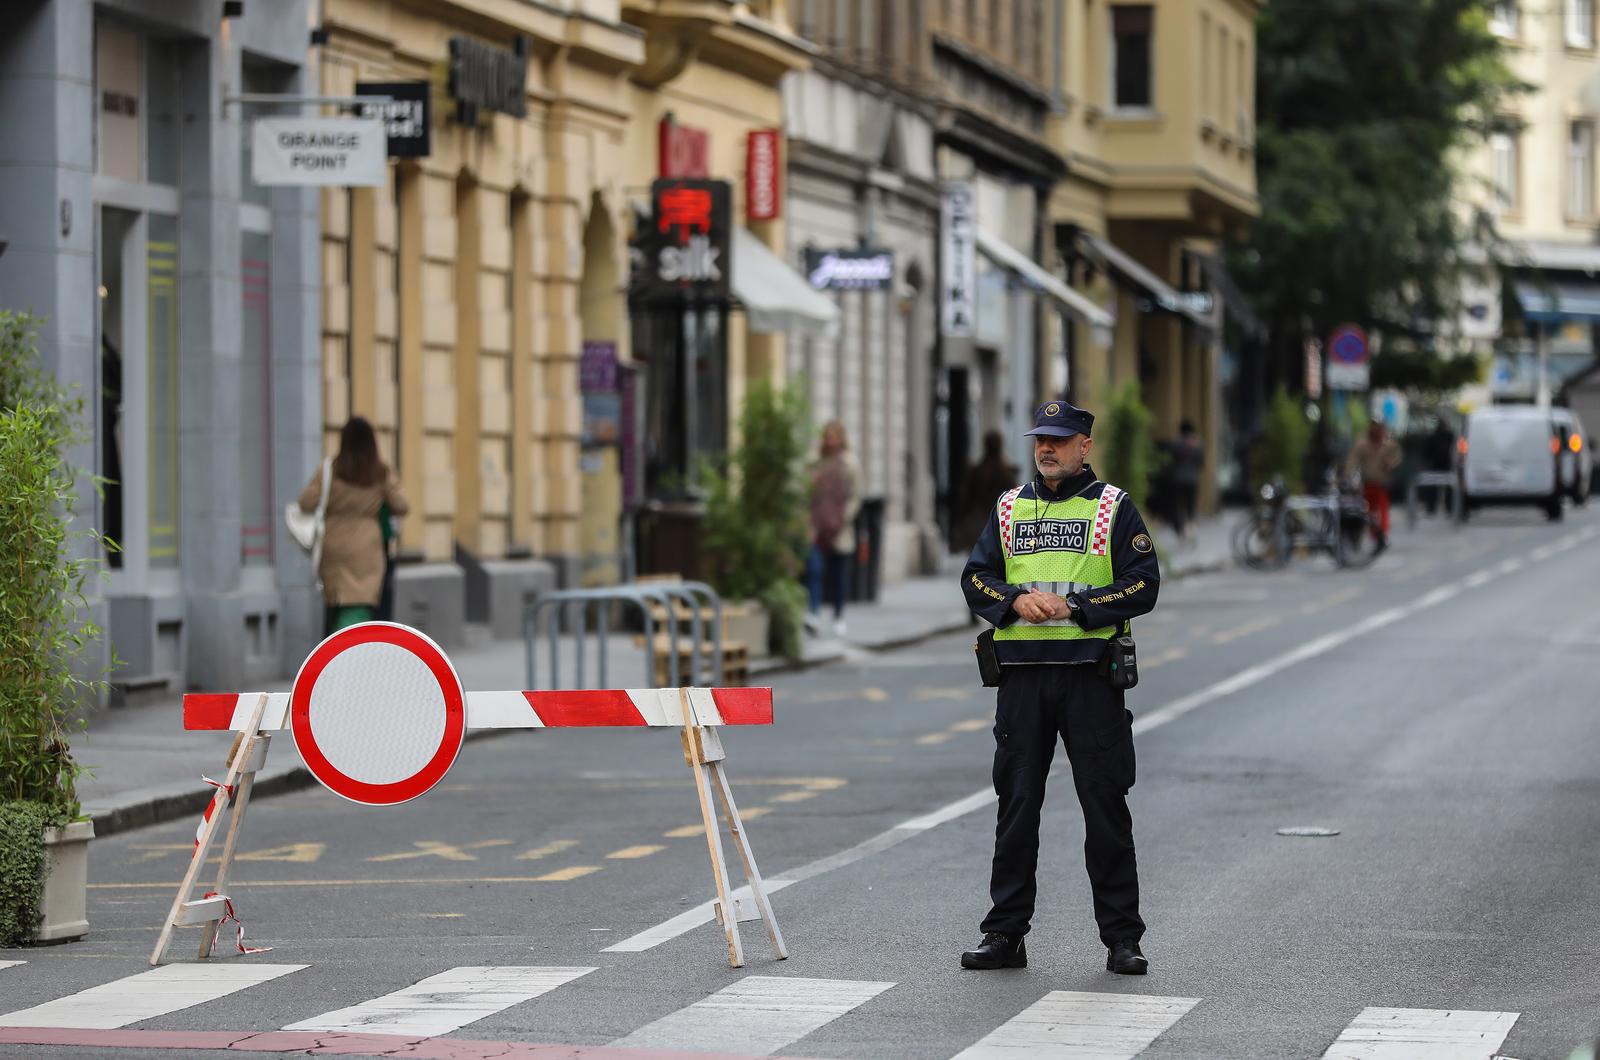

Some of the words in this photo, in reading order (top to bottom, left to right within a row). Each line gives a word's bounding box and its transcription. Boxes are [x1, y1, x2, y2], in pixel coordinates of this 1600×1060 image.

[279, 132, 360, 148] ORANGE
[290, 153, 348, 169] POINT
[753, 135, 774, 216] KONZUM
[658, 235, 722, 282] silk
[946, 184, 972, 328] OPTIKA
[1019, 522, 1082, 536] PROMETNO
[1016, 534, 1083, 550] REDARSTVO
